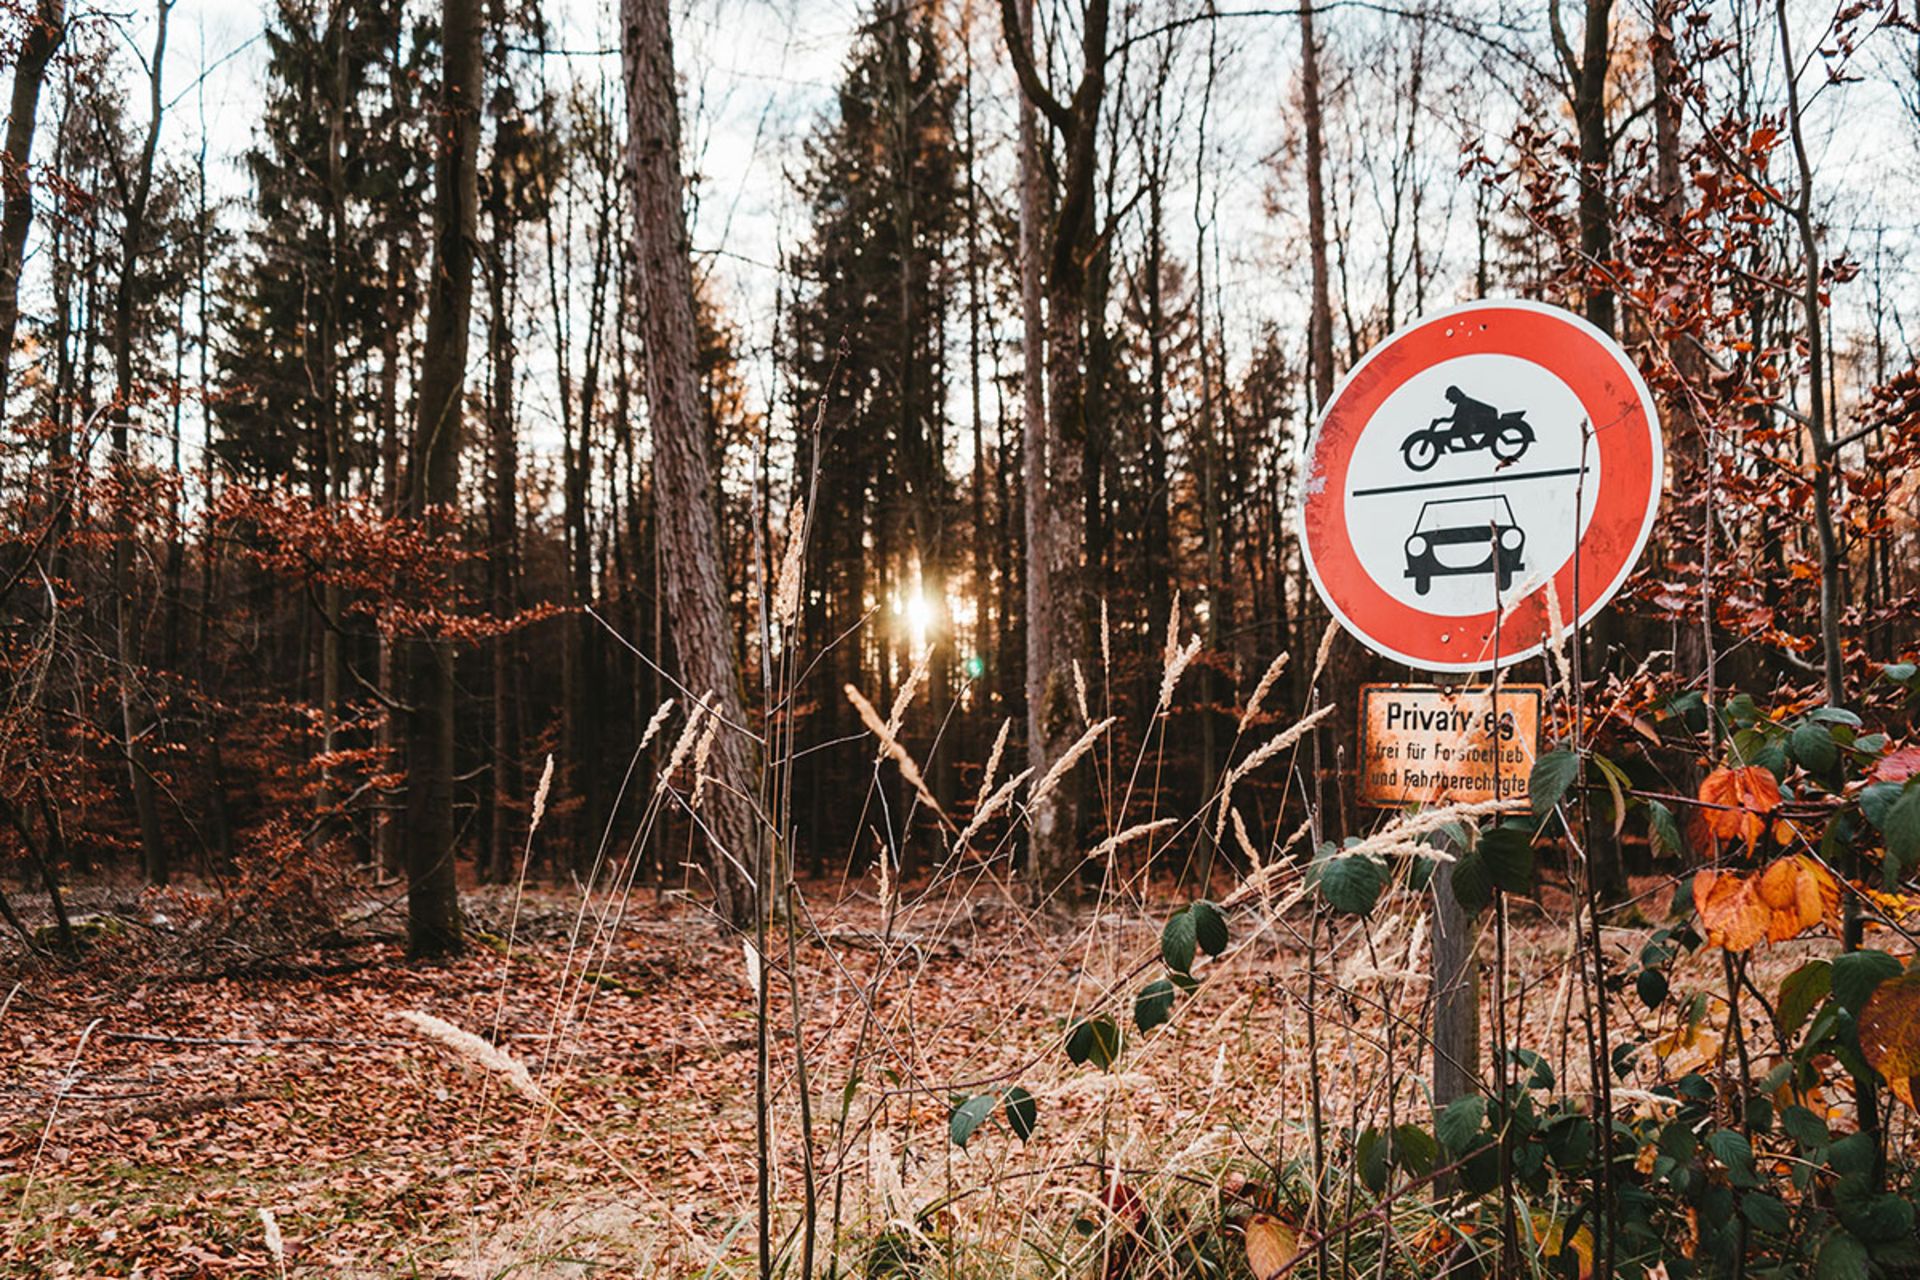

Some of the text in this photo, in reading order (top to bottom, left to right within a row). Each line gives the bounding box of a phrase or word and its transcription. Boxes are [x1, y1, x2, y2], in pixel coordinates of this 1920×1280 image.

[1375, 741, 1524, 763] frei für Fostbetieb
[1371, 769, 1526, 797] und Fahrtberechtgte
